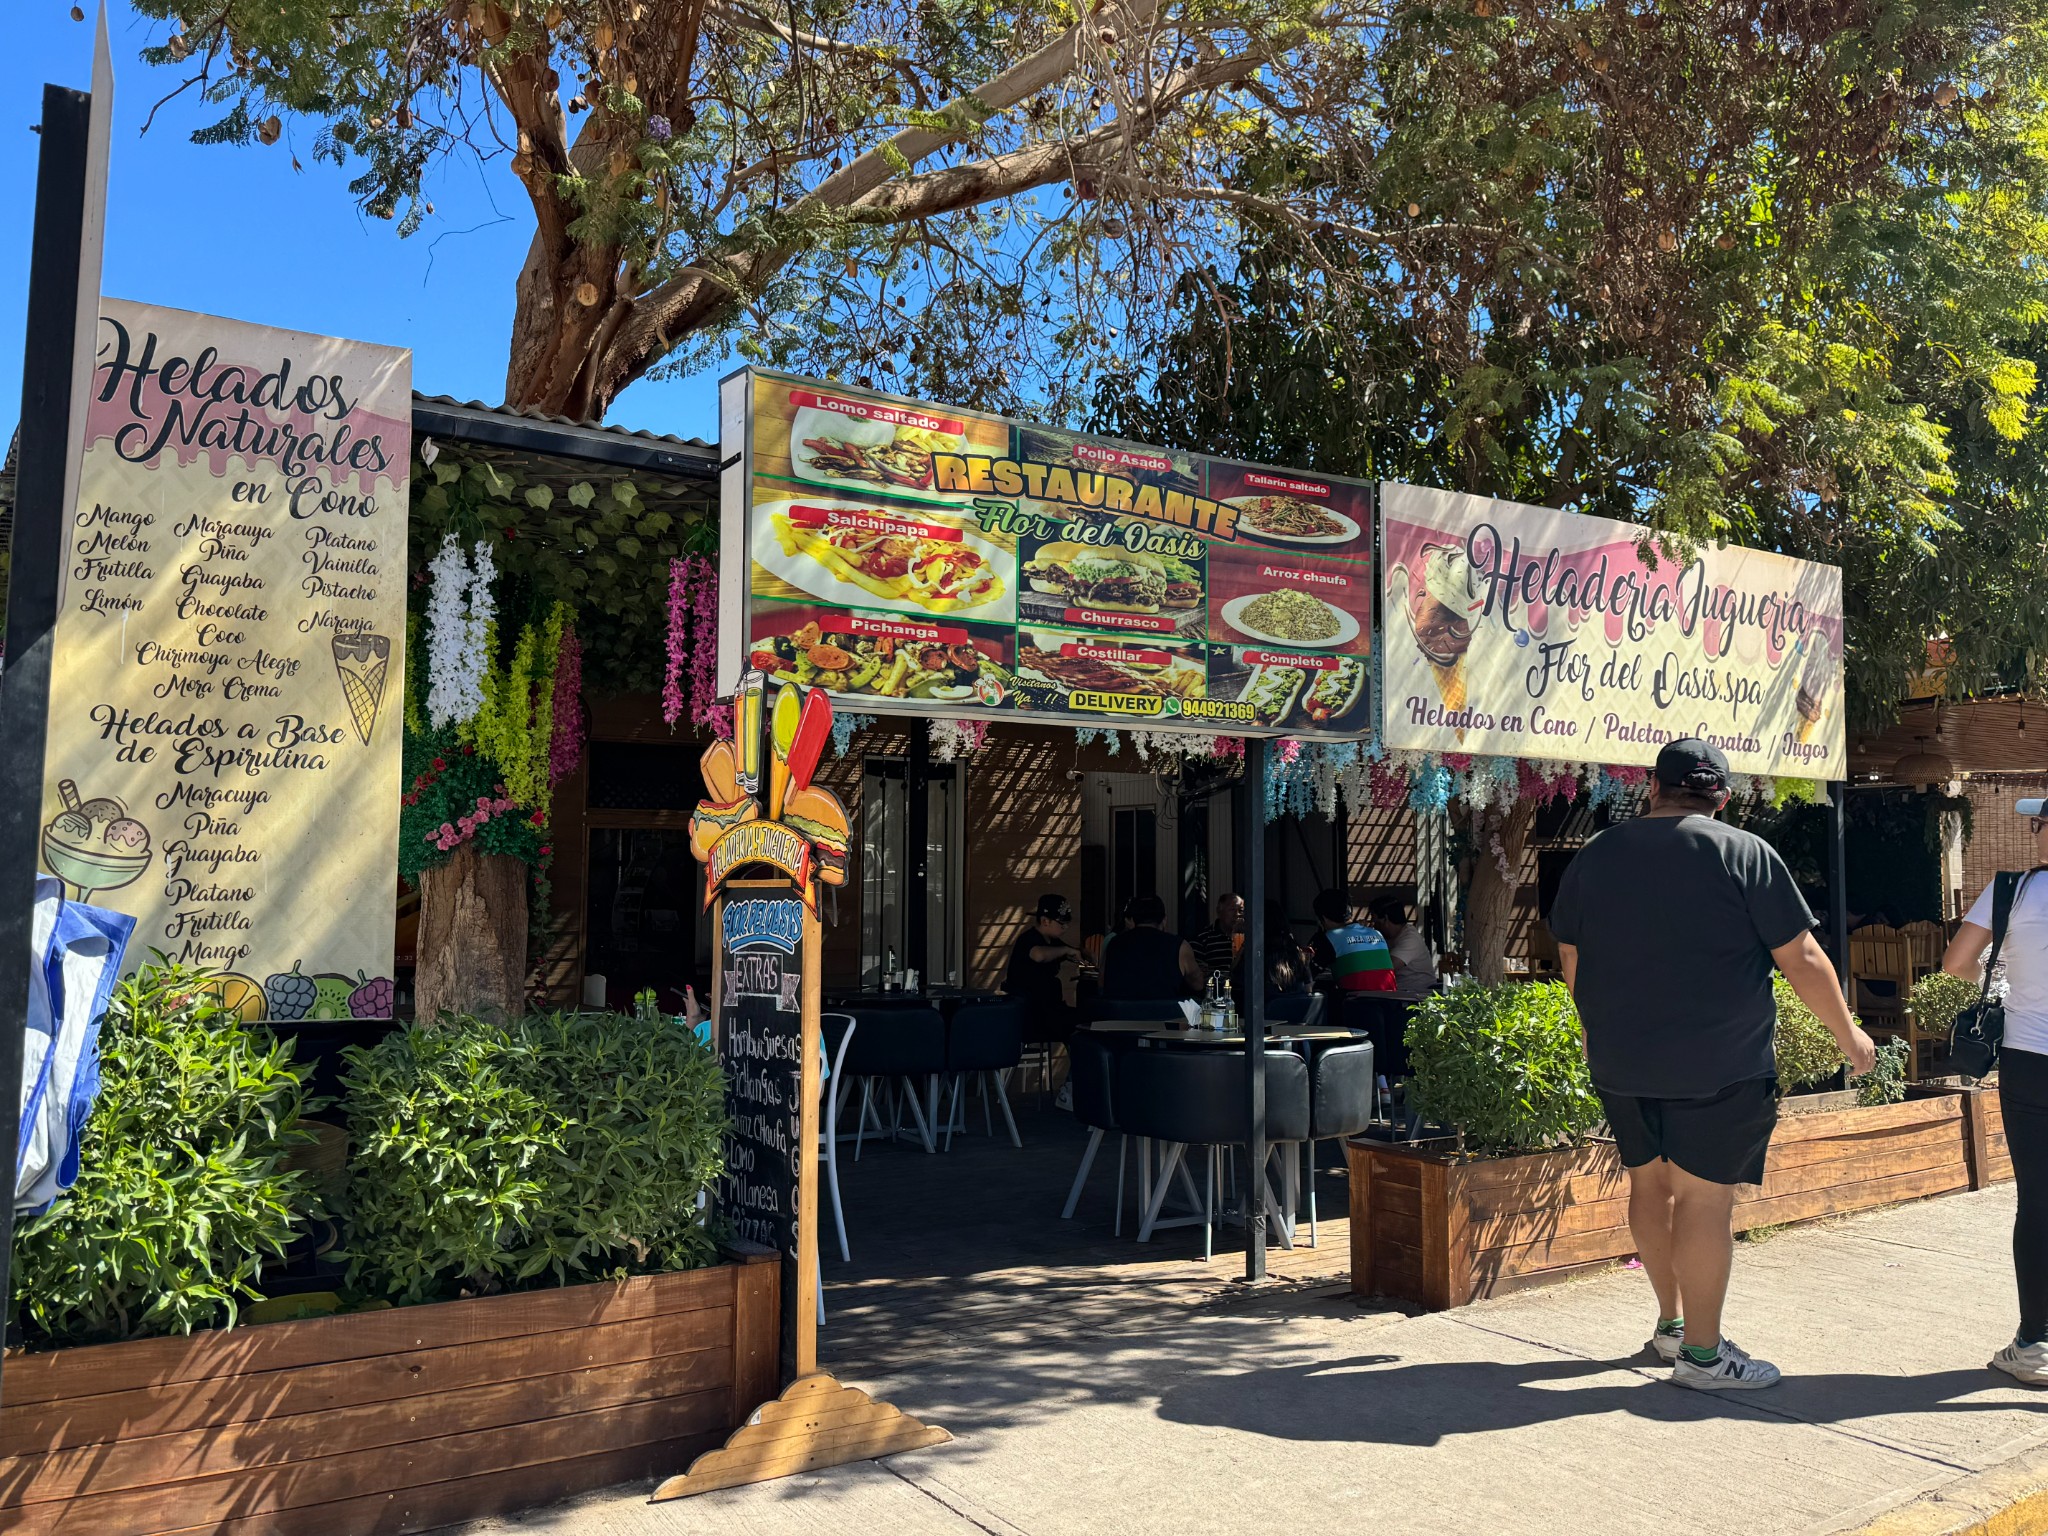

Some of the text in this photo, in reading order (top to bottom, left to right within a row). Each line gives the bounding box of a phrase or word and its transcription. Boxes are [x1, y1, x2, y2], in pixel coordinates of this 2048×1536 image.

[97, 316, 358, 420] Helados
[816, 396, 940, 430] Lomo saltado
[115, 399, 394, 477] Naturales
[1077, 445, 1167, 471] Pollo Asado
[232, 476, 379, 519] en Cono
[932, 453, 1240, 541] RESTAURANTE
[1289, 482, 1327, 494] saltado
[76, 503, 156, 535] Mango
[174, 514, 275, 547] Maracuya
[827, 512, 929, 537] Salchipapa
[974, 498, 1208, 560] Flor del Oasis
[77, 530, 151, 555] Melón
[199, 538, 249, 562] Piña
[305, 526, 378, 551] Platano
[74, 556, 155, 582] Frutilla
[302, 551, 380, 576] Vainilla
[1263, 566, 1347, 586] Arroz chaufa
[180, 564, 266, 596] Guayaba
[302, 576, 378, 600] Pistacho
[1466, 522, 1809, 658] Heladeria Jugueria
[80, 588, 144, 618] Limón
[176, 595, 269, 622] Chocolate
[298, 609, 377, 639] Naranja
[851, 619, 939, 639] Pichanga
[1081, 611, 1160, 629] Churrasco
[197, 623, 246, 647] Coco
[136, 641, 302, 680] Chirimoya Alegre
[1077, 646, 1142, 662] Costillar
[1260, 653, 1324, 668] Completo
[1010, 676, 1057, 690] Visitanos
[1526, 637, 1595, 701] Flor
[1599, 650, 1643, 691] del
[153, 673, 282, 701] Mora Crema
[1075, 693, 1158, 711] DELIVERY
[1182, 699, 1255, 720] 944921369
[90, 704, 346, 749] Helados a Base
[1406, 696, 1496, 731] Helados
[1501, 715, 1524, 733] en
[1530, 705, 1578, 737] Cono
[1603, 713, 1672, 745] Paletas
[1782, 732, 1829, 766] Jugos
[116, 737, 330, 777] de Espirulina
[155, 781, 272, 814] Maracuya
[184, 812, 242, 840] Piña
[163, 840, 262, 878] Guayaba
[165, 877, 256, 906] Platano
[165, 908, 255, 938] Frutilla
[167, 939, 252, 971] Mango
[736, 956, 779, 990] EXTRAS
[1724, 1360, 1745, 1380] N
